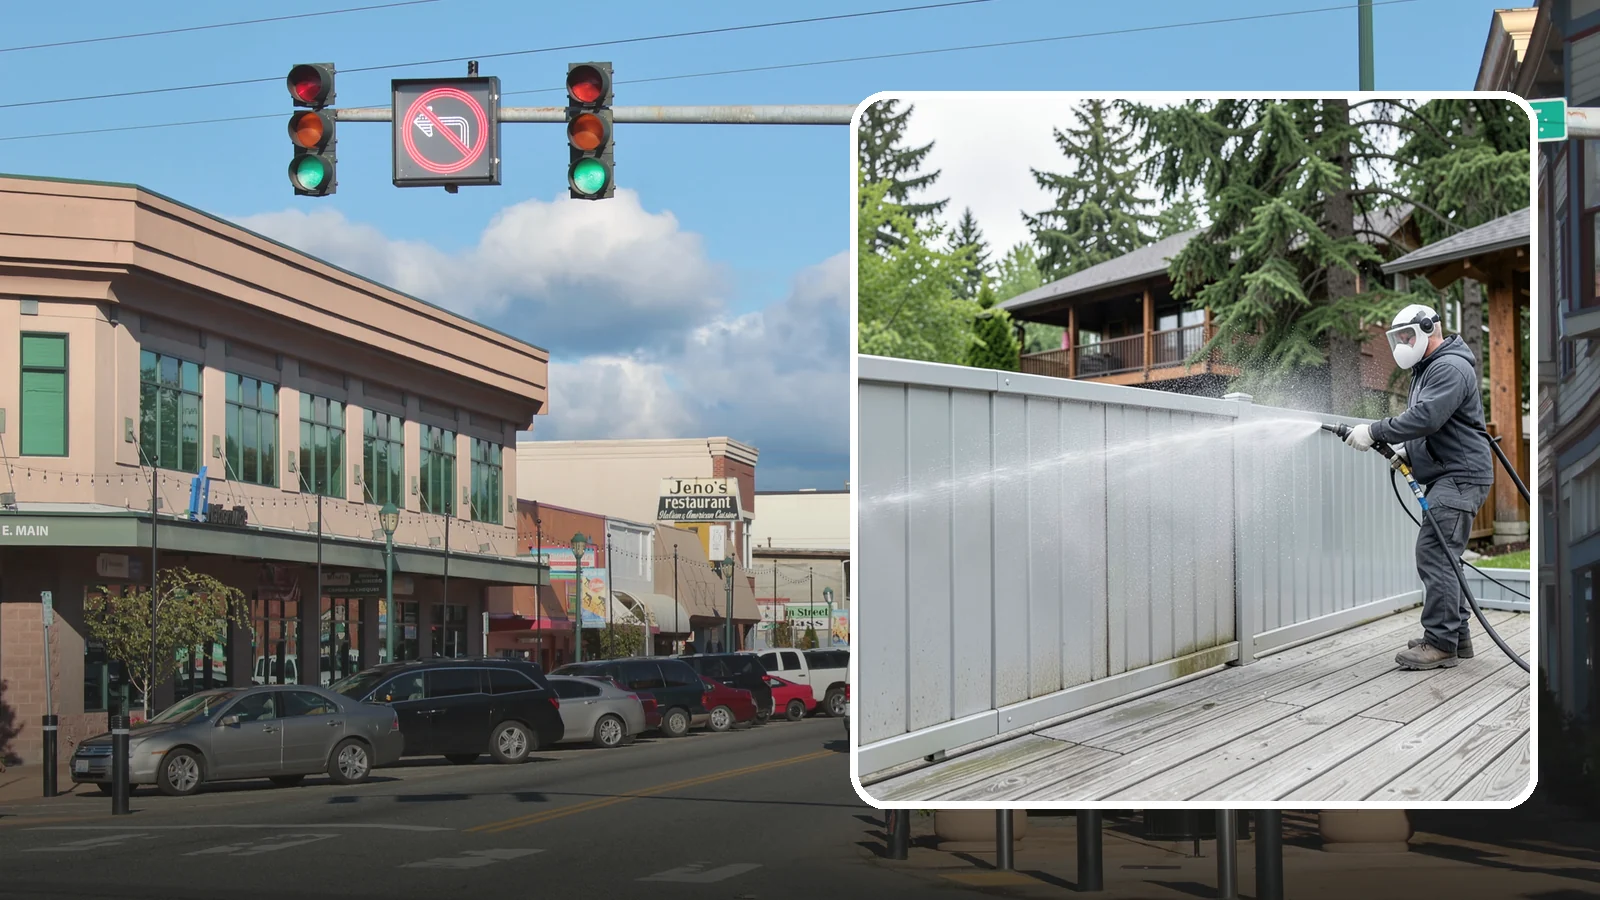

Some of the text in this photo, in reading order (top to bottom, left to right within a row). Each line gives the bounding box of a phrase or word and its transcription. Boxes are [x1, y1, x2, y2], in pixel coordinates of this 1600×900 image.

[669, 480, 728, 495] Jeno's
[665, 496, 731, 509] restaurant
[686, 509, 715, 519] American
[715, 509, 737, 519] Cuisine
[2, 525, 49, 536] E. MAIN
[797, 607, 828, 617] Street
